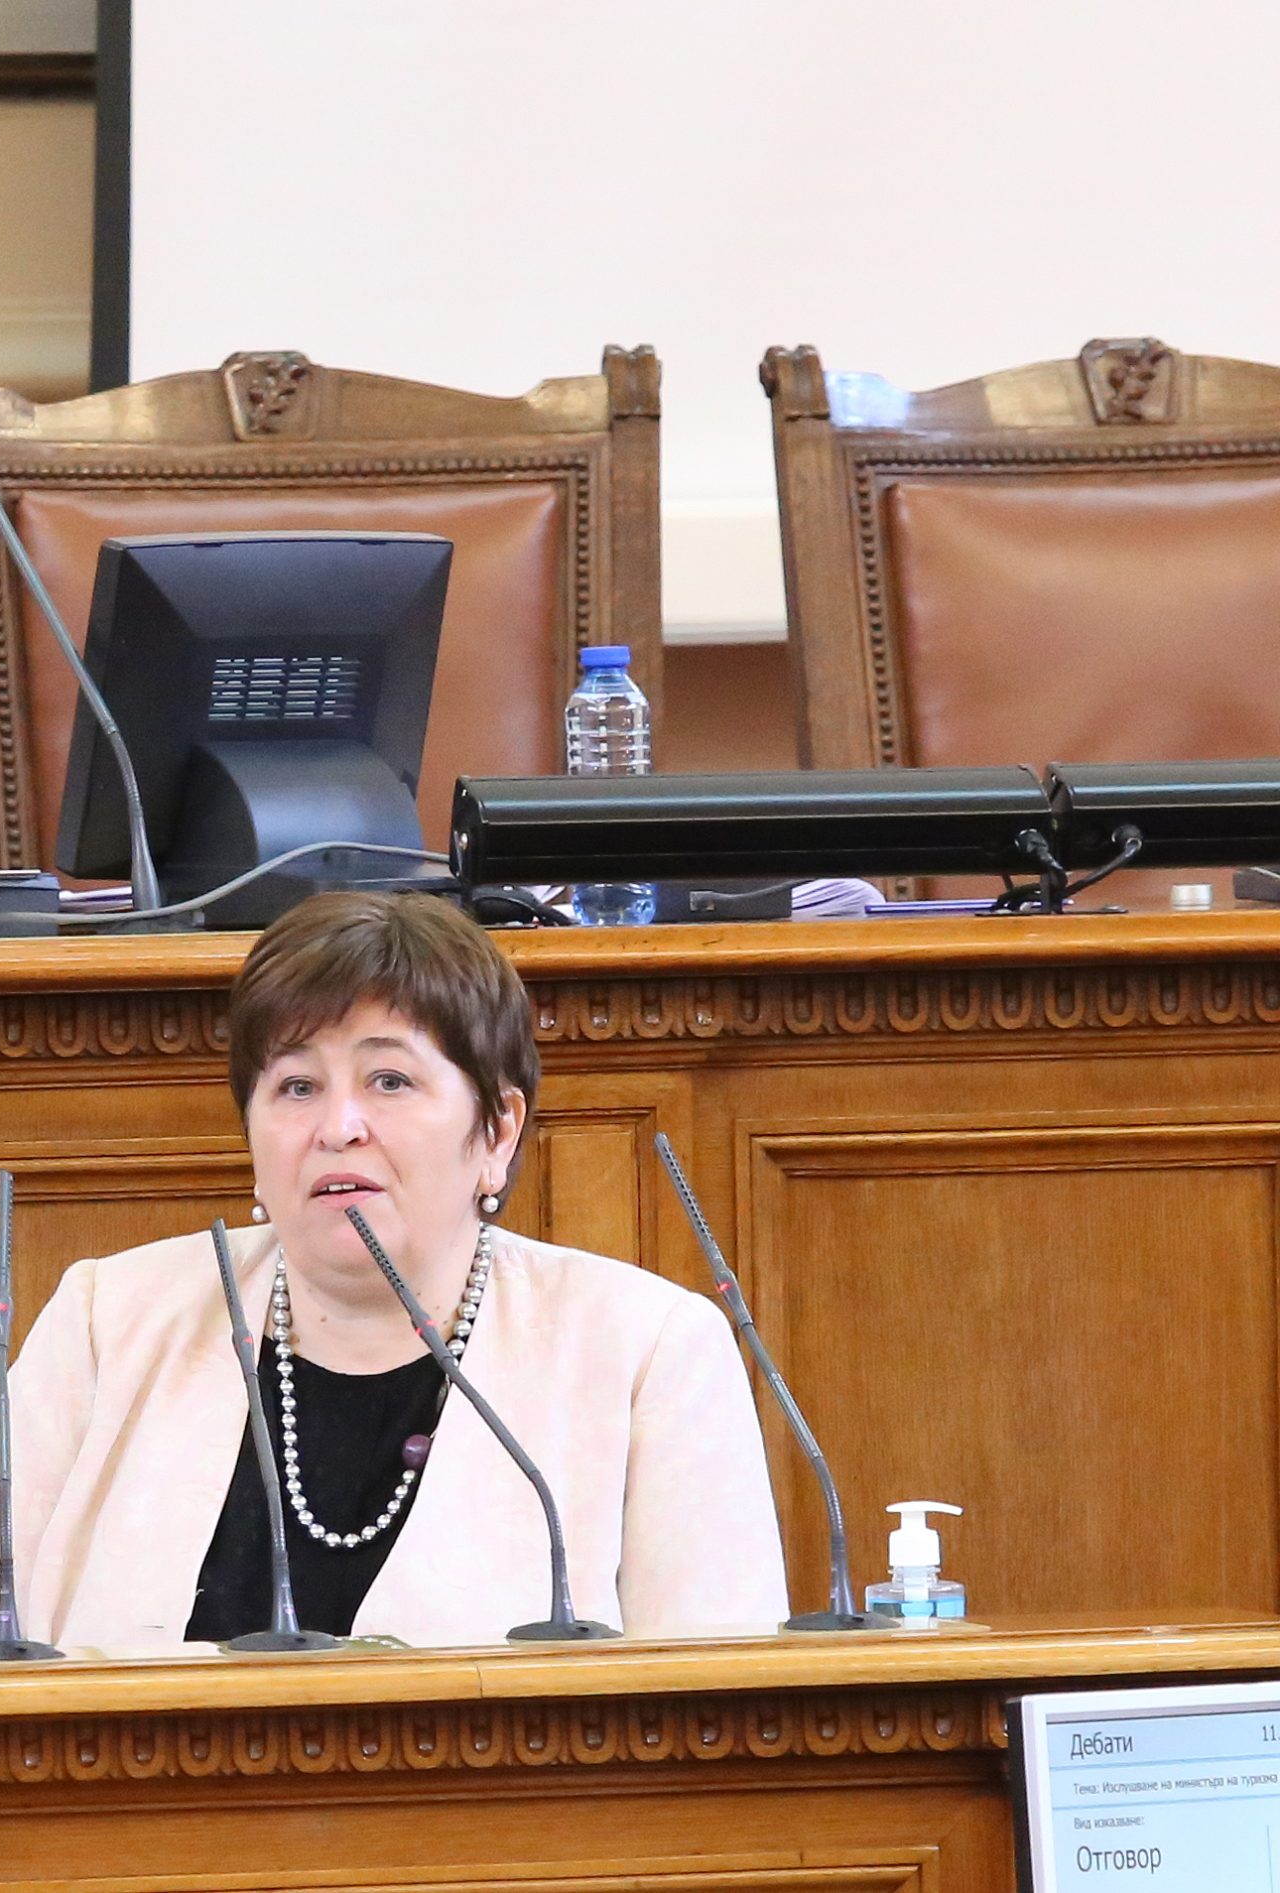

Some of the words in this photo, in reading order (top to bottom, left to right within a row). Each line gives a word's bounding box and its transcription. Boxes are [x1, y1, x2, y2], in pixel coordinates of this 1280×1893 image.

[1071, 1732, 1133, 1760] Дебати
[1073, 1782, 1100, 1795] Тема:
[1161, 1780, 1173, 1790] на
[1227, 1776, 1239, 1787] на
[1074, 1816, 1092, 1830] Вид
[1076, 1845, 1162, 1874] Отговор
